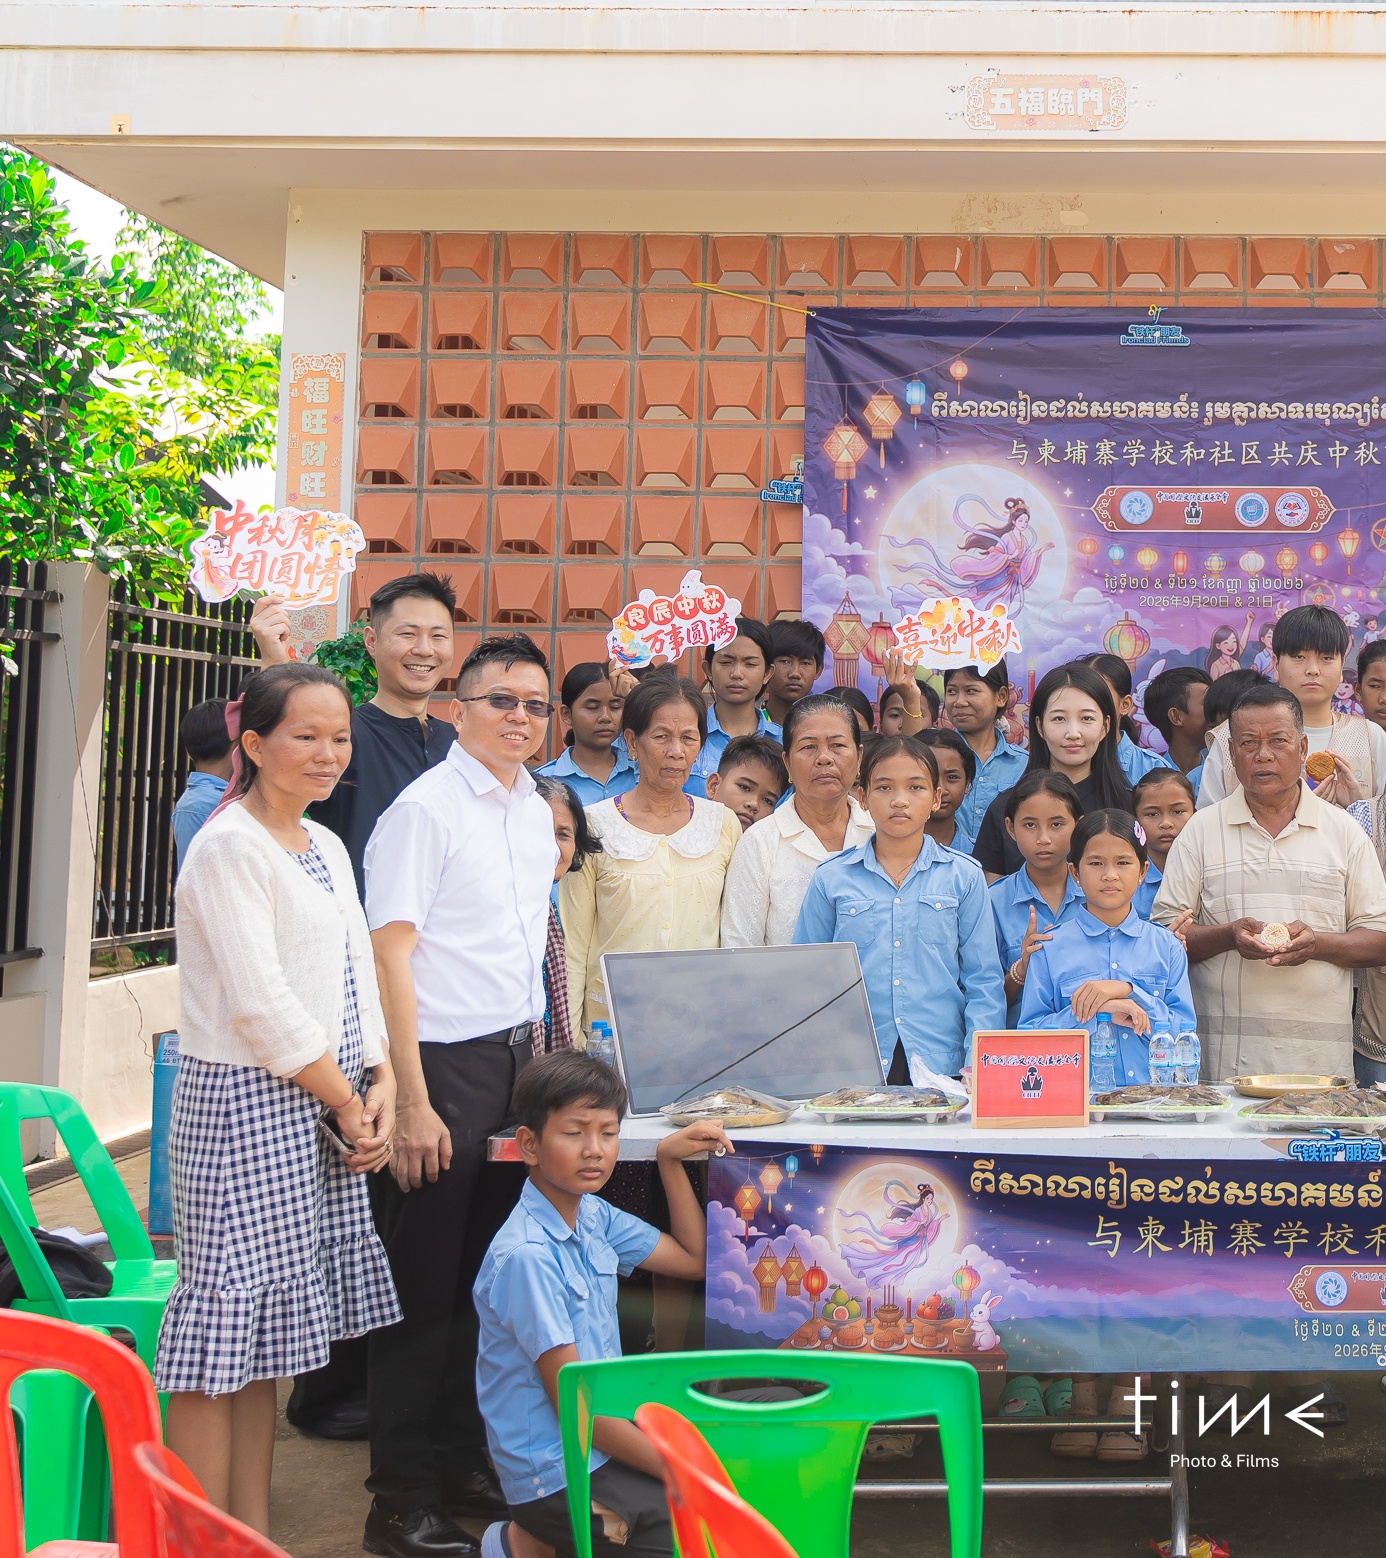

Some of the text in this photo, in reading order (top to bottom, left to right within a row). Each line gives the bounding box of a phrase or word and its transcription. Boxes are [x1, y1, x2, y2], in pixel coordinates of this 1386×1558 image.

[988, 87, 1104, 117] 五福臨門
[299, 377, 330, 511] 福旺财旺
[213, 500, 322, 556] 中秋月
[230, 549, 345, 602] 团圆情
[1154, 578, 1163, 589] &
[627, 590, 722, 627] 良辰中秋
[1139, 595, 1273, 609] 2026年9月20日 & 21日
[641, 612, 736, 661] 万事圆满
[893, 608, 1020, 662] 喜迎中秋
[1294, 1144, 1380, 1161] “铁杆”朋友
[1351, 1324, 1361, 1337] &
